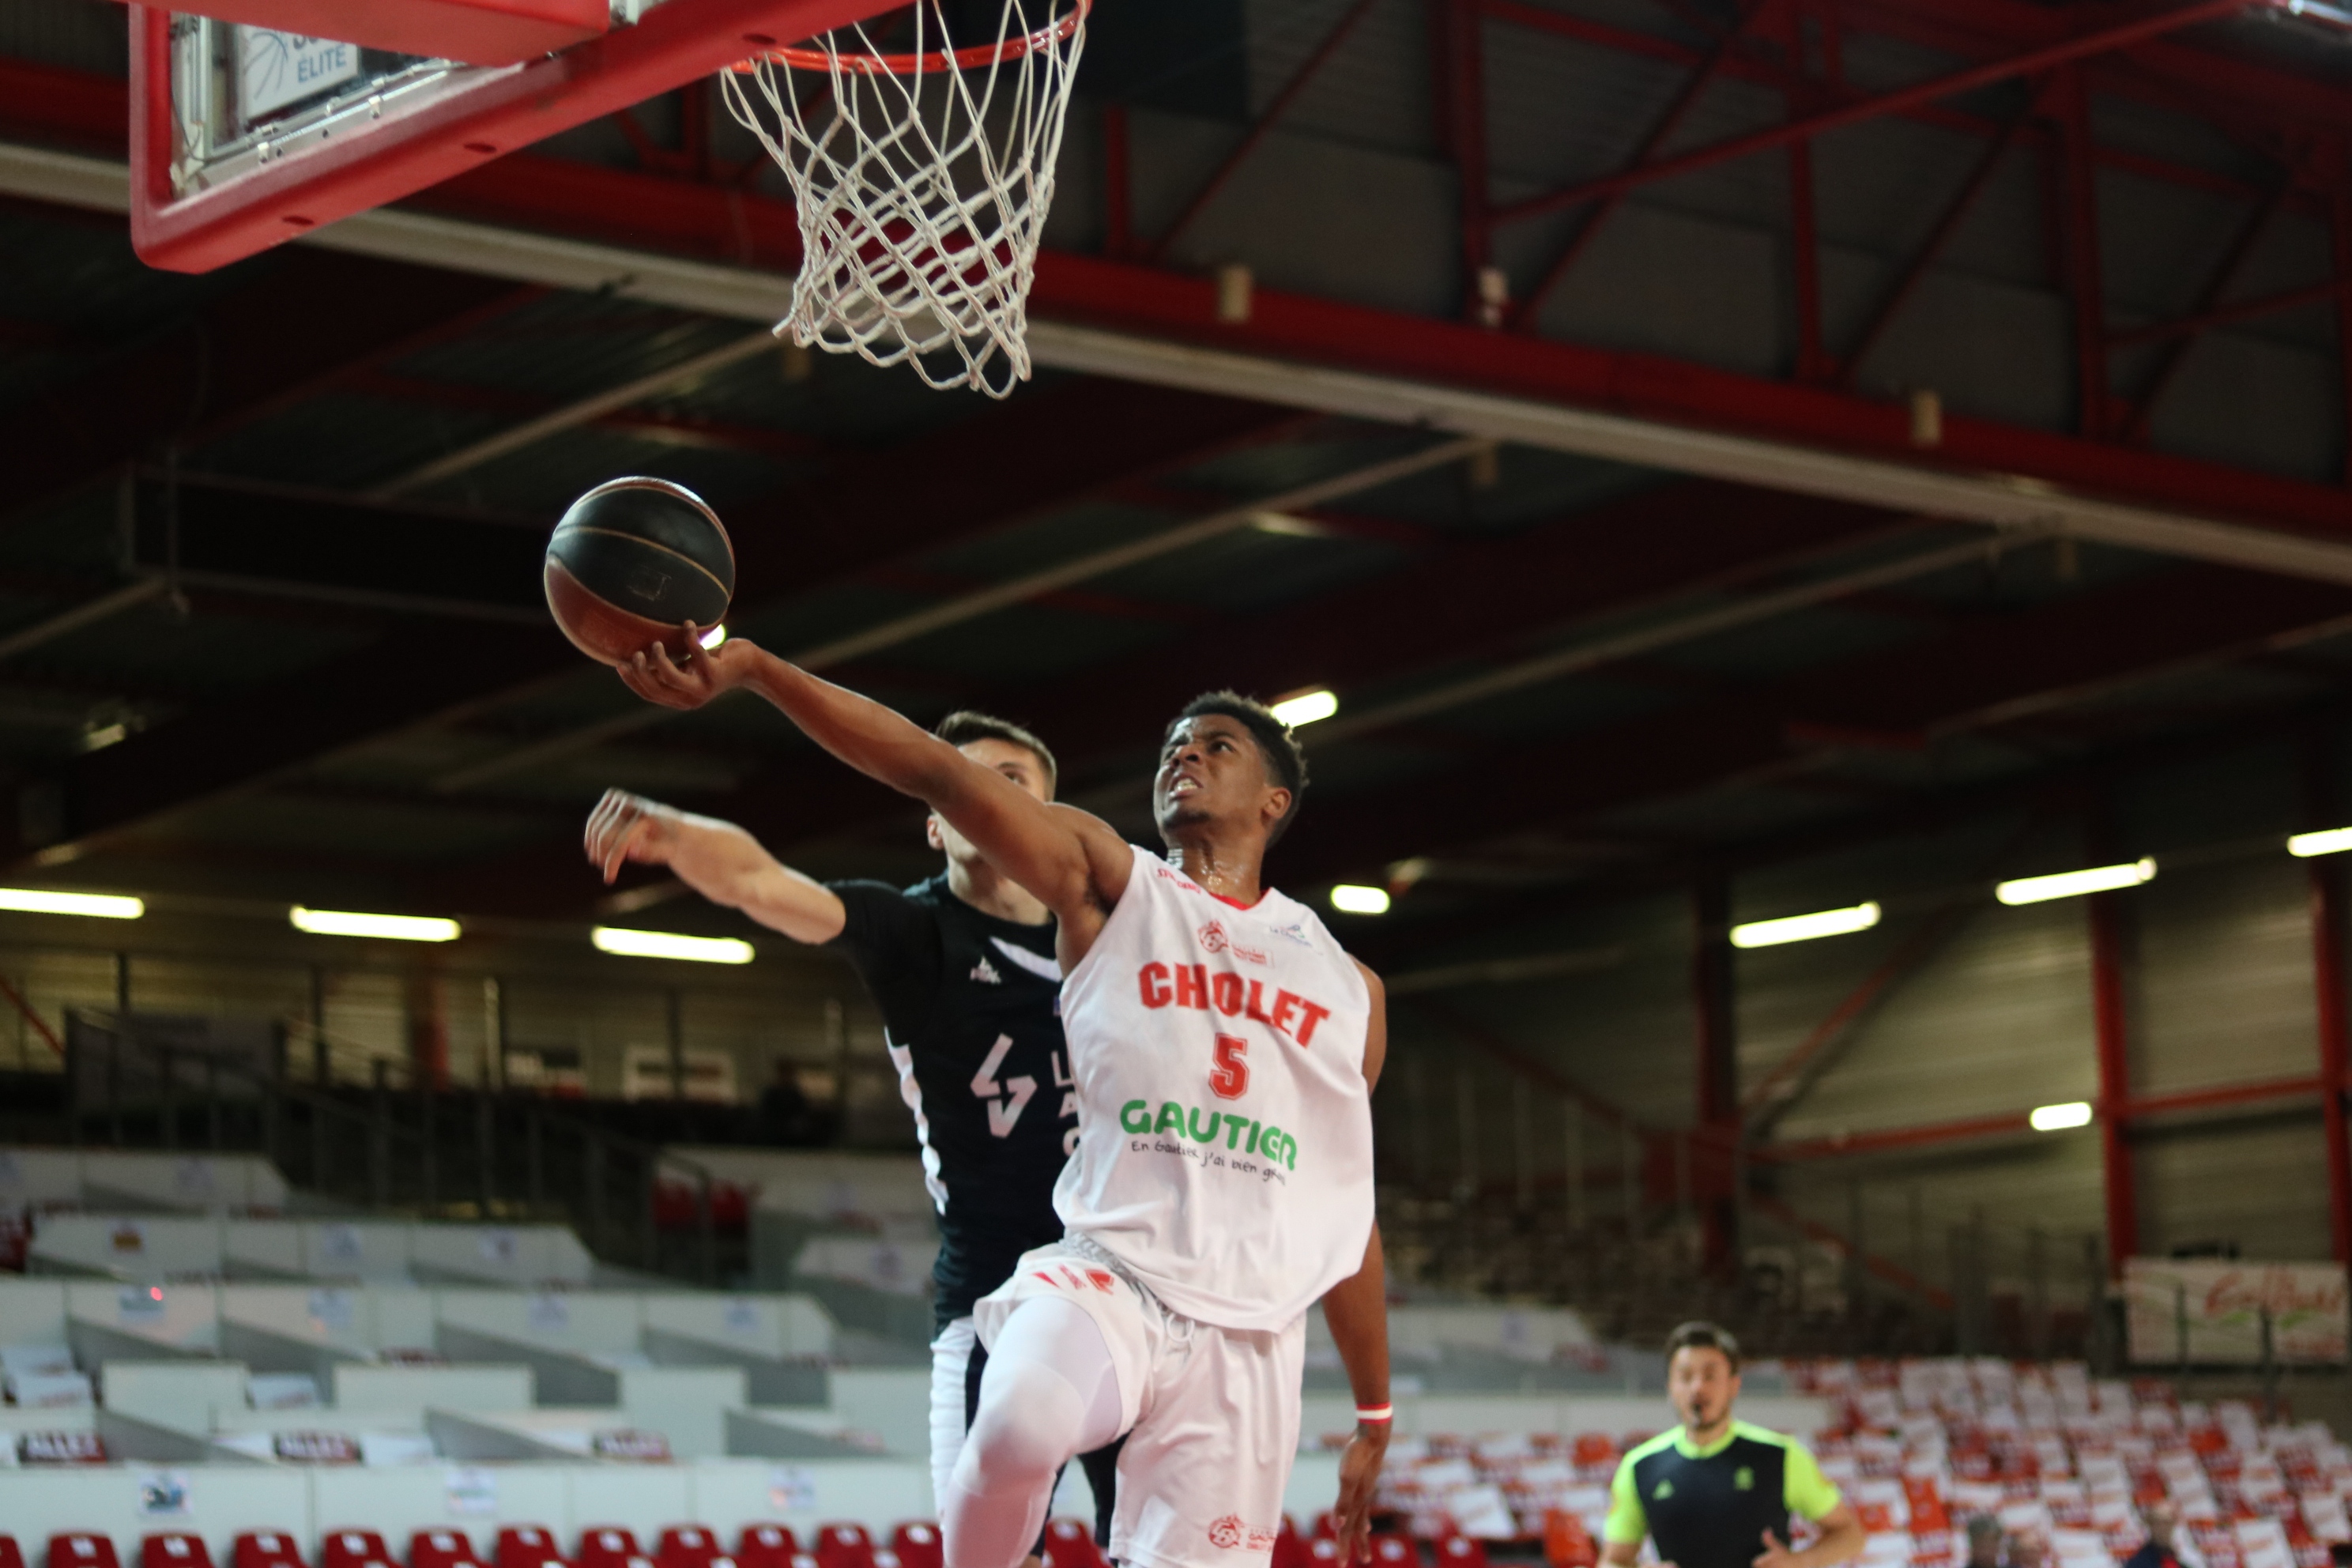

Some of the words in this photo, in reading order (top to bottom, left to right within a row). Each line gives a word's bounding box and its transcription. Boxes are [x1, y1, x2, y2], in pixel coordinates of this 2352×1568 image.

[1138, 961, 1331, 1049] CHOLET
[1208, 1032, 1250, 1101] 5
[1120, 1099, 1297, 1171] GAUTIER
[1131, 1140, 1149, 1152] En
[1200, 1151, 1225, 1167] j'ai
